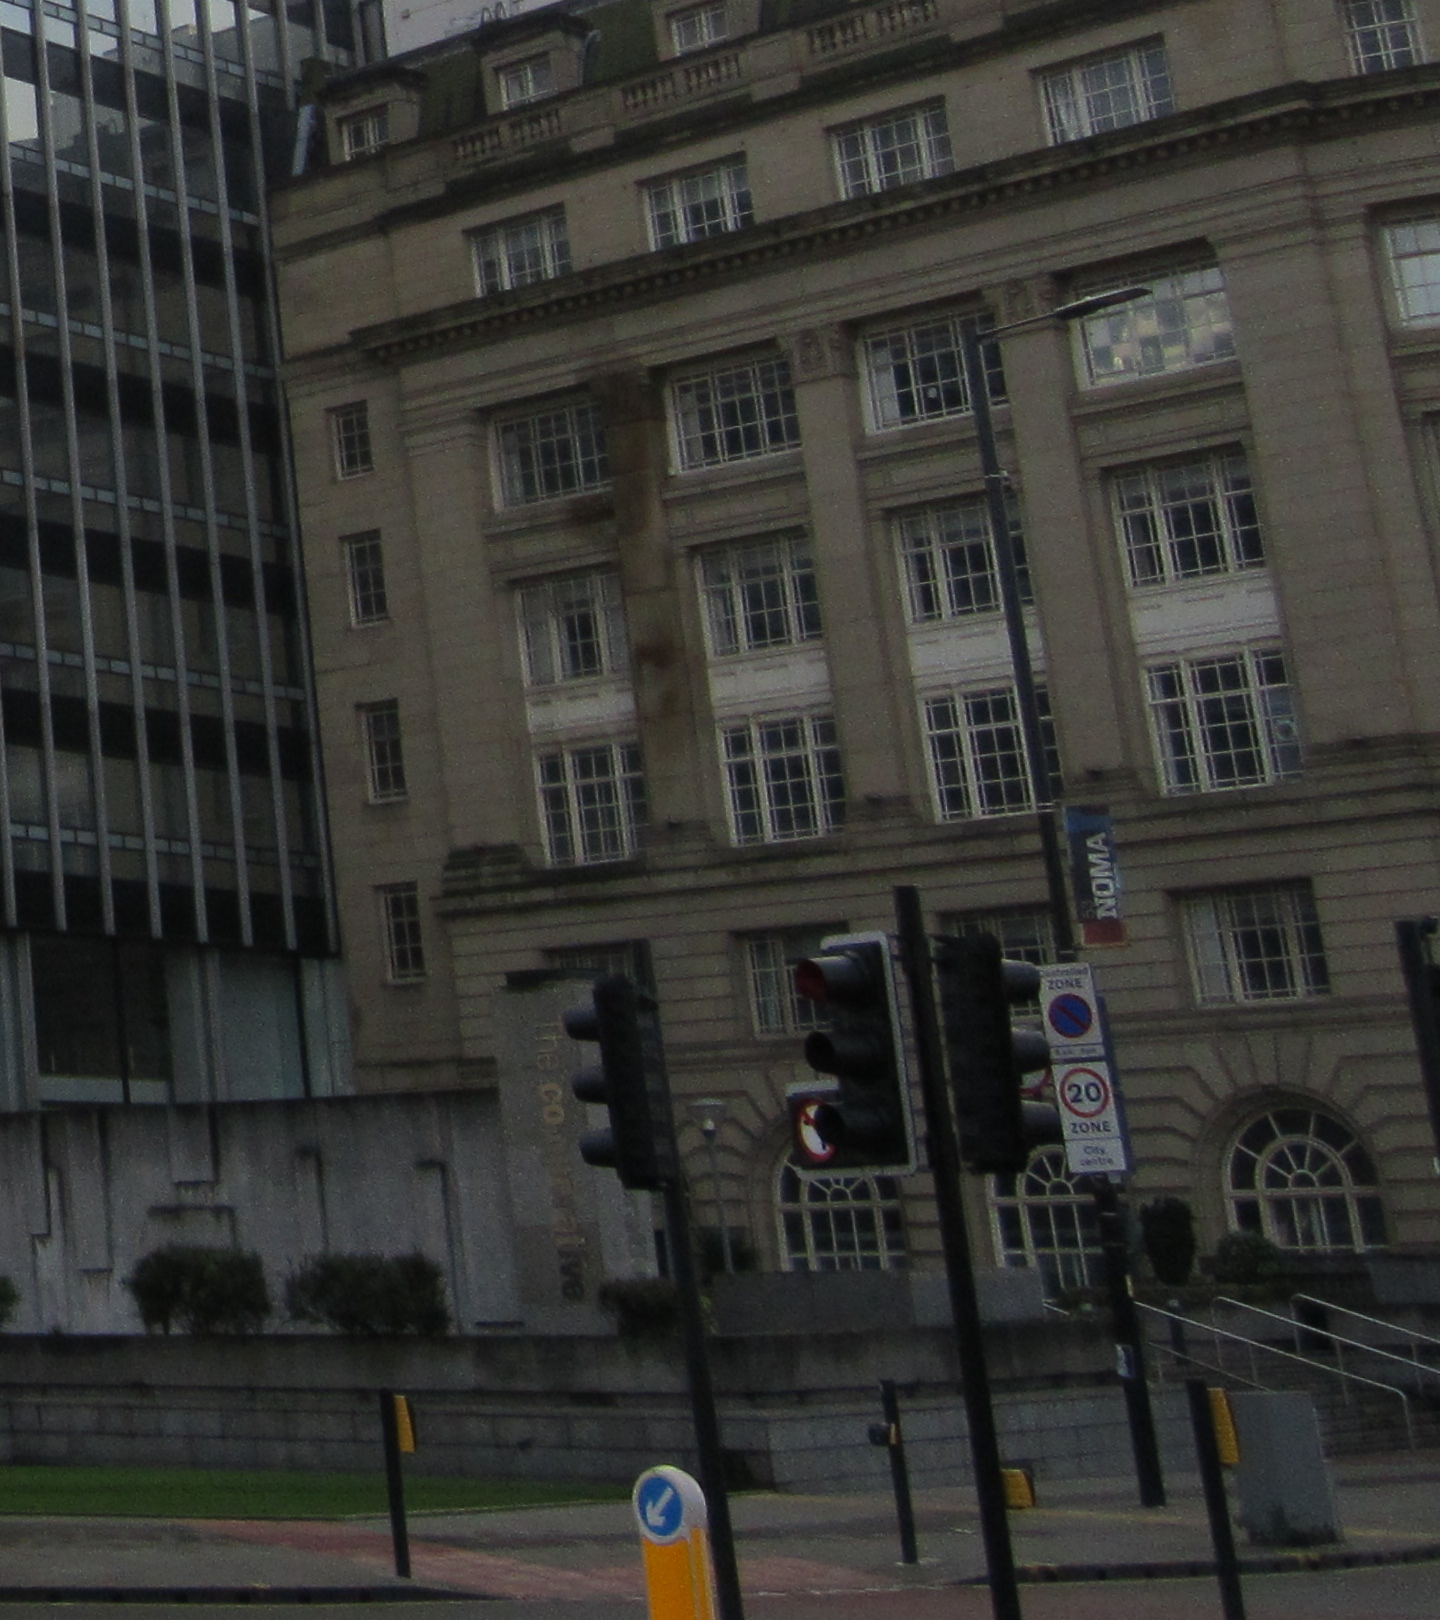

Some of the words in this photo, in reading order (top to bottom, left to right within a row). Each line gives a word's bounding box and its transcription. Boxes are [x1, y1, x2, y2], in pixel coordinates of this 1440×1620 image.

[1085, 832, 1119, 920] NOMA
[1048, 977, 1083, 990] ZONE
[1068, 1084, 1101, 1103] 20
[1071, 1121, 1112, 1134] ZONE
[1083, 1146, 1106, 1157] City
